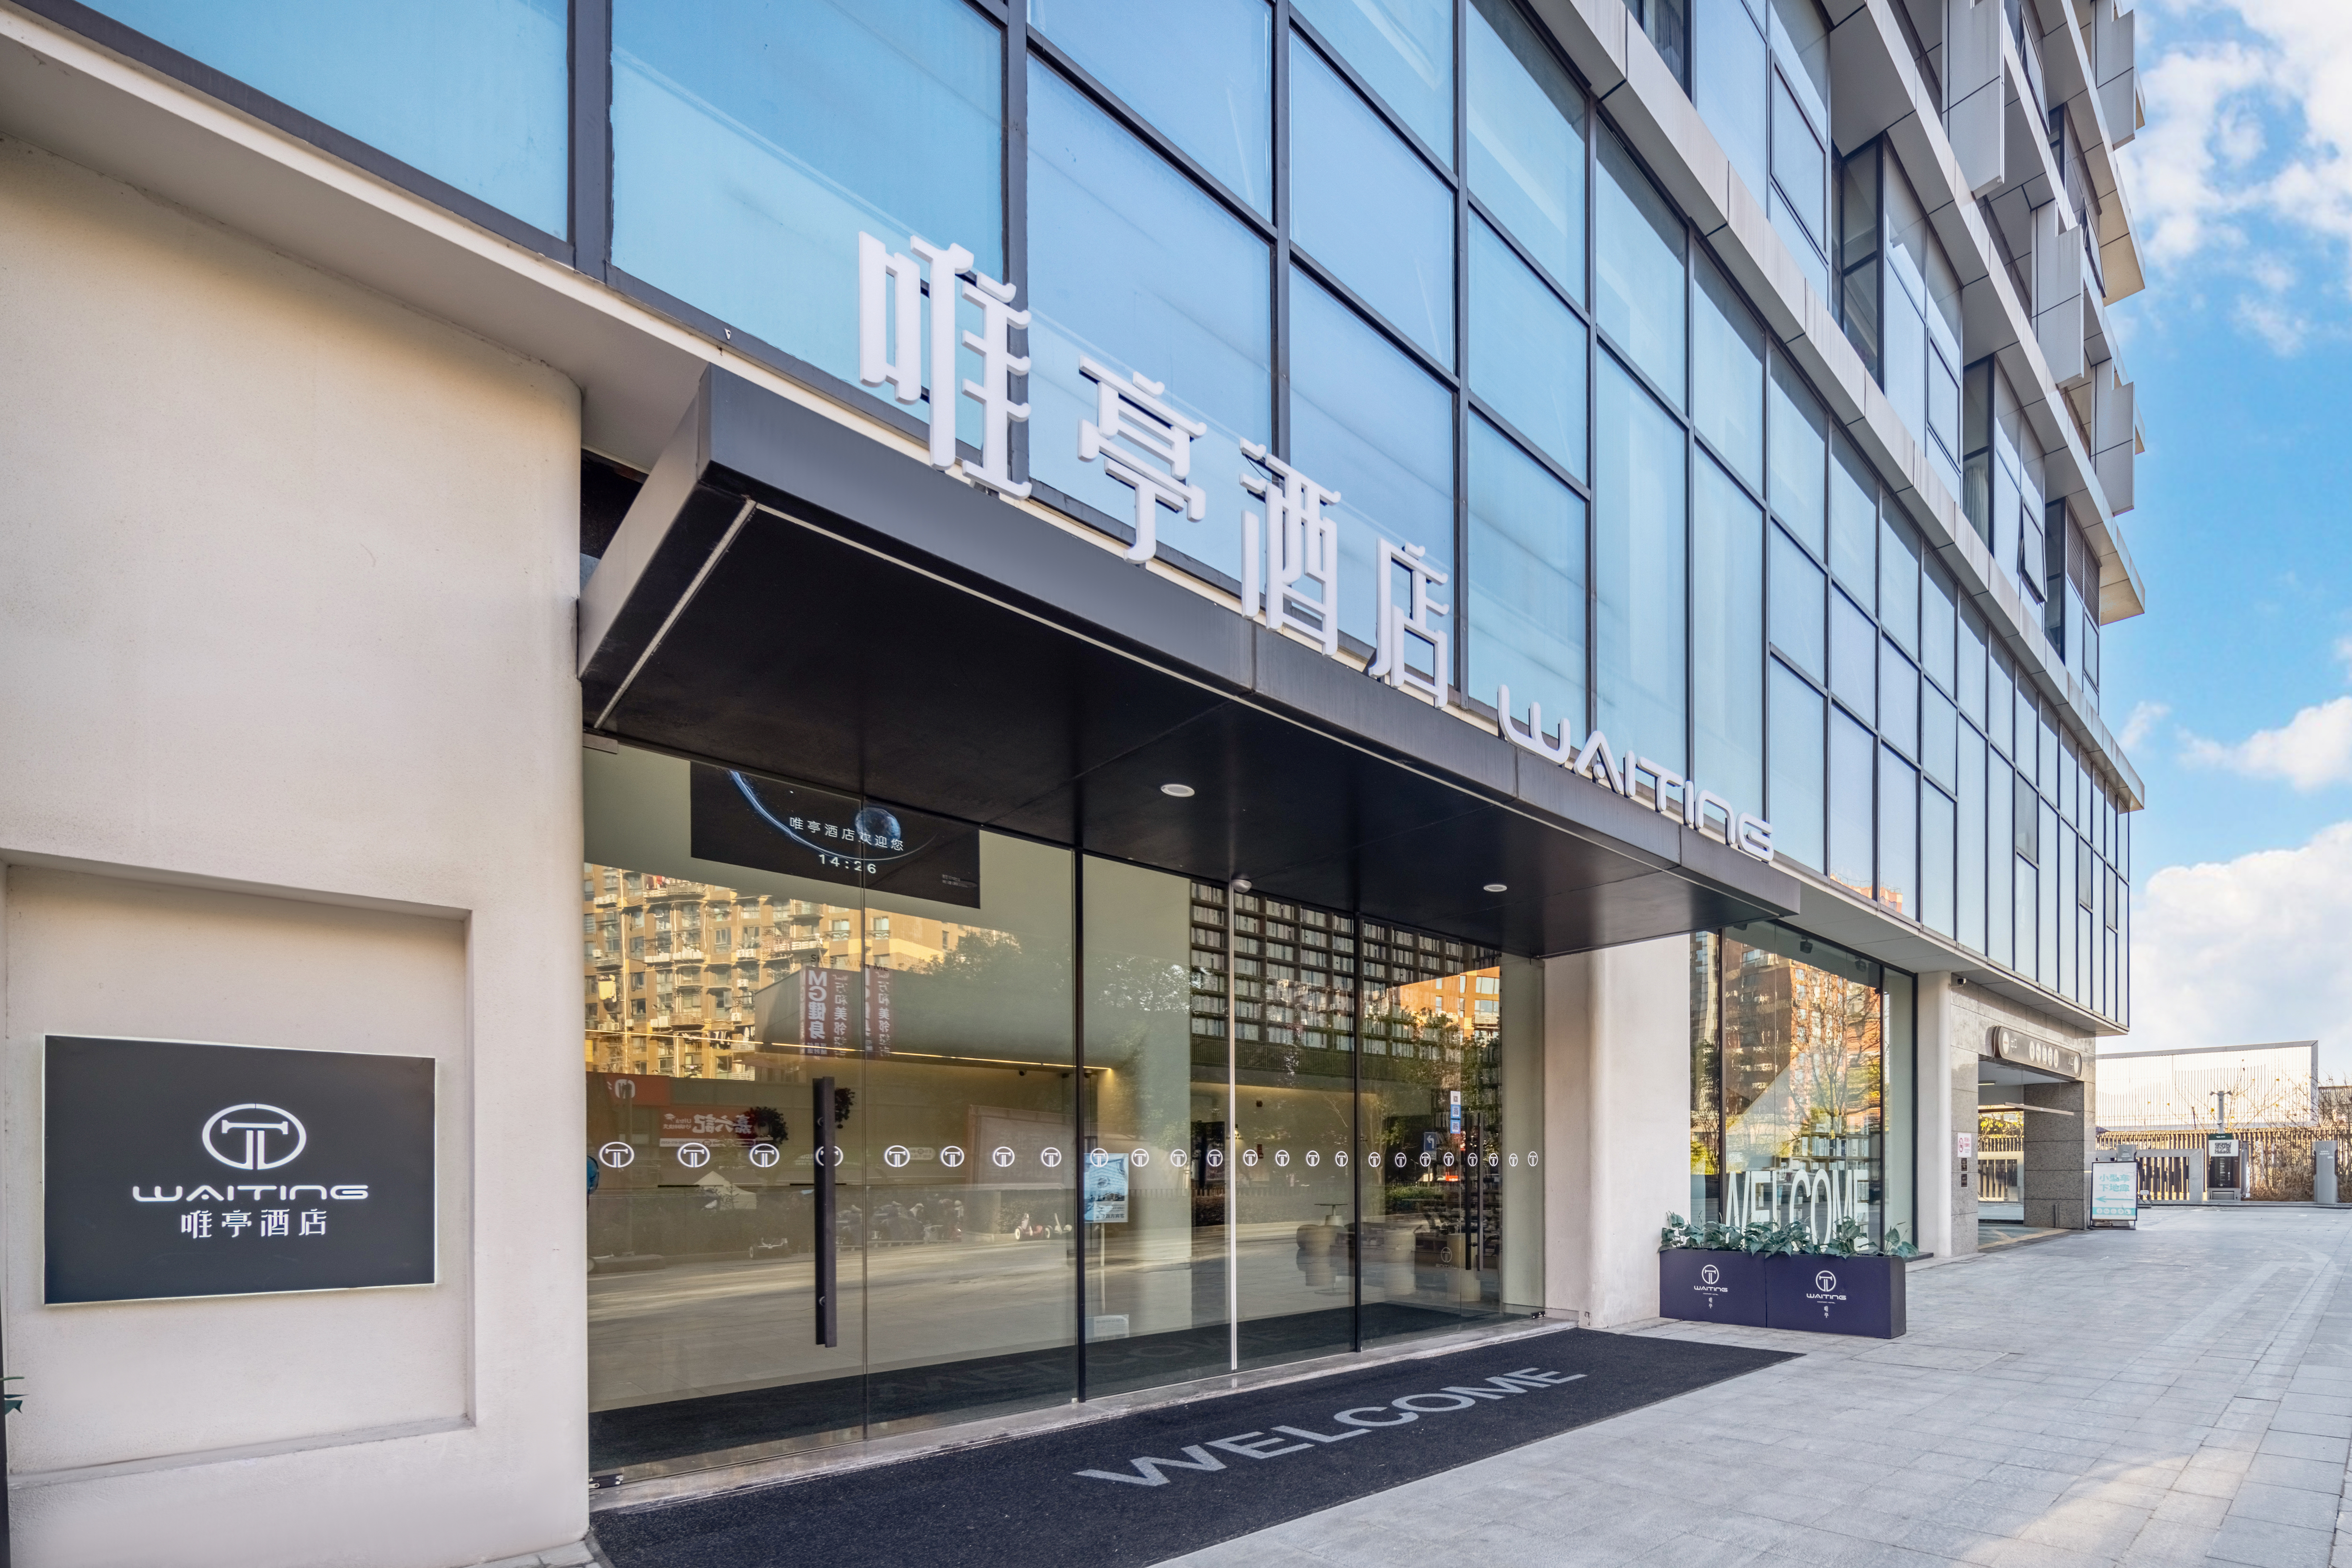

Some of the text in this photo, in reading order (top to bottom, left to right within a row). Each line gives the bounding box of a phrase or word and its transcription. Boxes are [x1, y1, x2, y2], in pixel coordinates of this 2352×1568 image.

[858, 231, 1449, 709] 唯亭酒店
[1497, 685, 1773, 862] WAITING
[789, 817, 903, 851] 唯亭酒店欢迎您
[819, 854, 876, 874] 14:26
[2010, 1037, 2017, 1049] 出口
[2099, 1174, 2130, 1183] 小型车
[2099, 1183, 2130, 1192] 下地库
[133, 1185, 369, 1202] WAITING
[181, 1208, 327, 1239] 唯亭酒店
[1073, 1367, 1588, 1487] WELCOME
